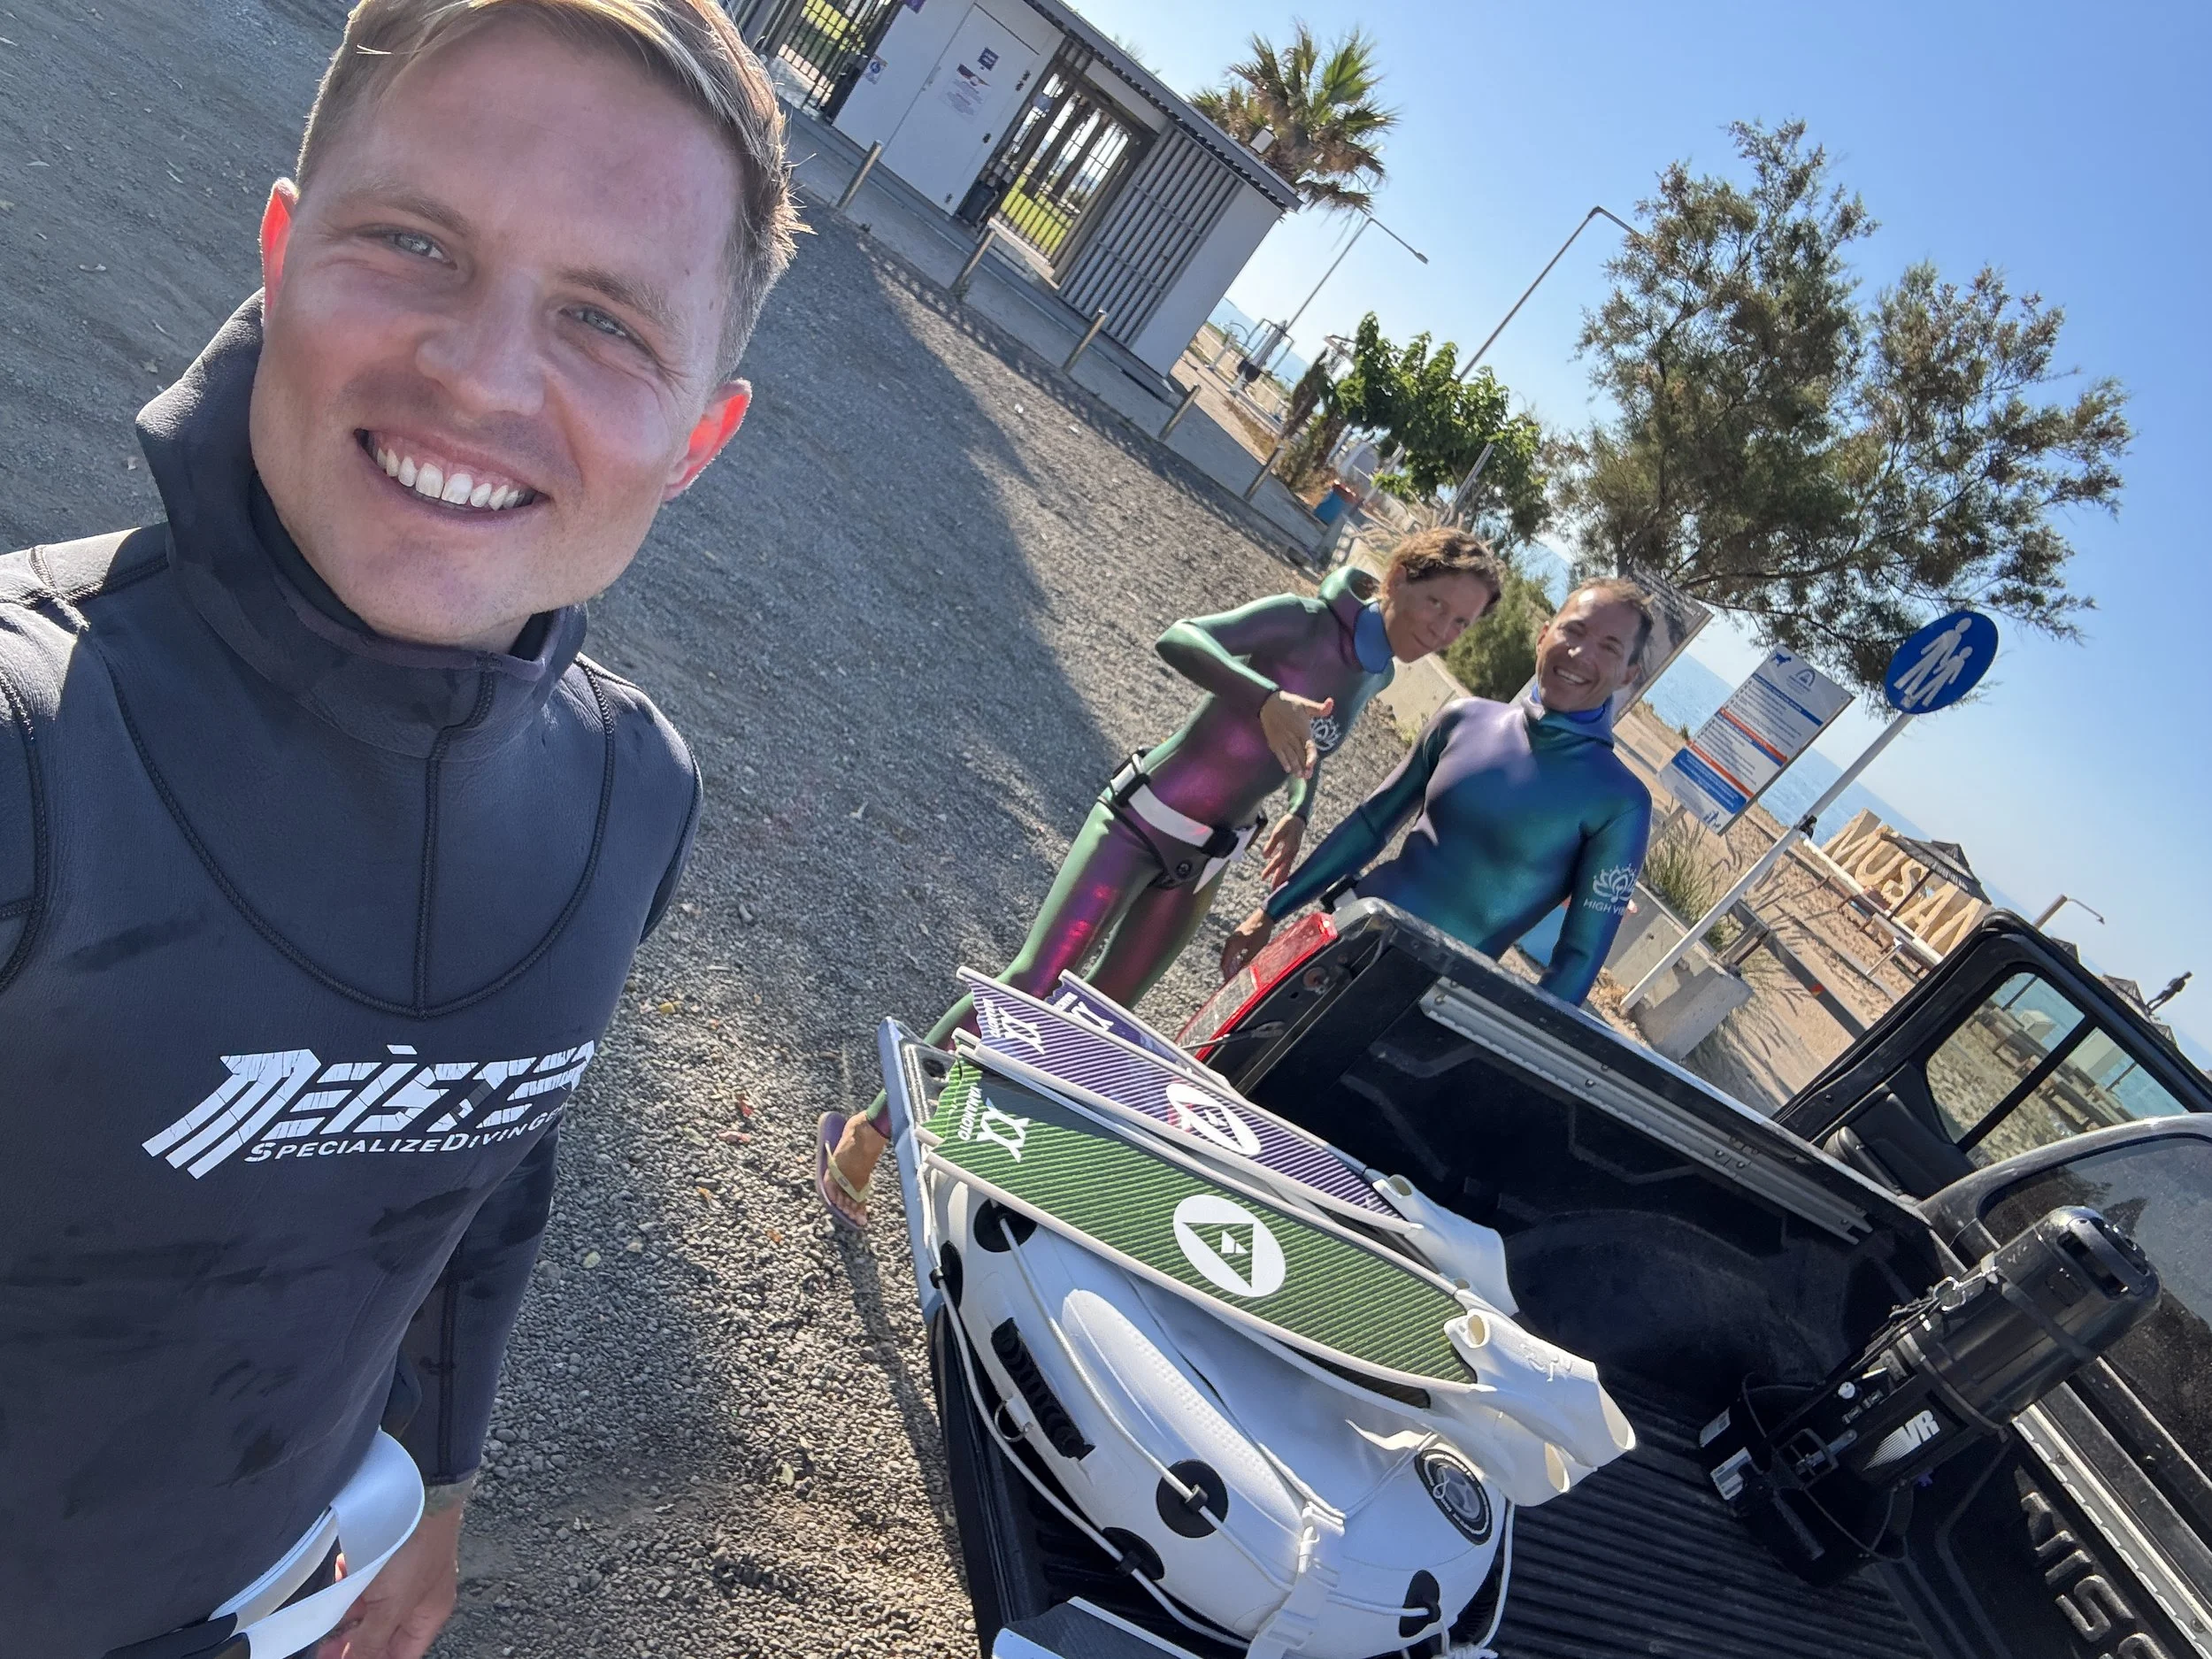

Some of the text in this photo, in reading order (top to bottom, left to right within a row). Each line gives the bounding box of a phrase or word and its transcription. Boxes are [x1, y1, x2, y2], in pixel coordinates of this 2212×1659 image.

[1583, 898, 1611, 913] HIGH
[958, 1087, 982, 1141] YAMAMOTO
[1887, 1409, 1940, 1457] VR
